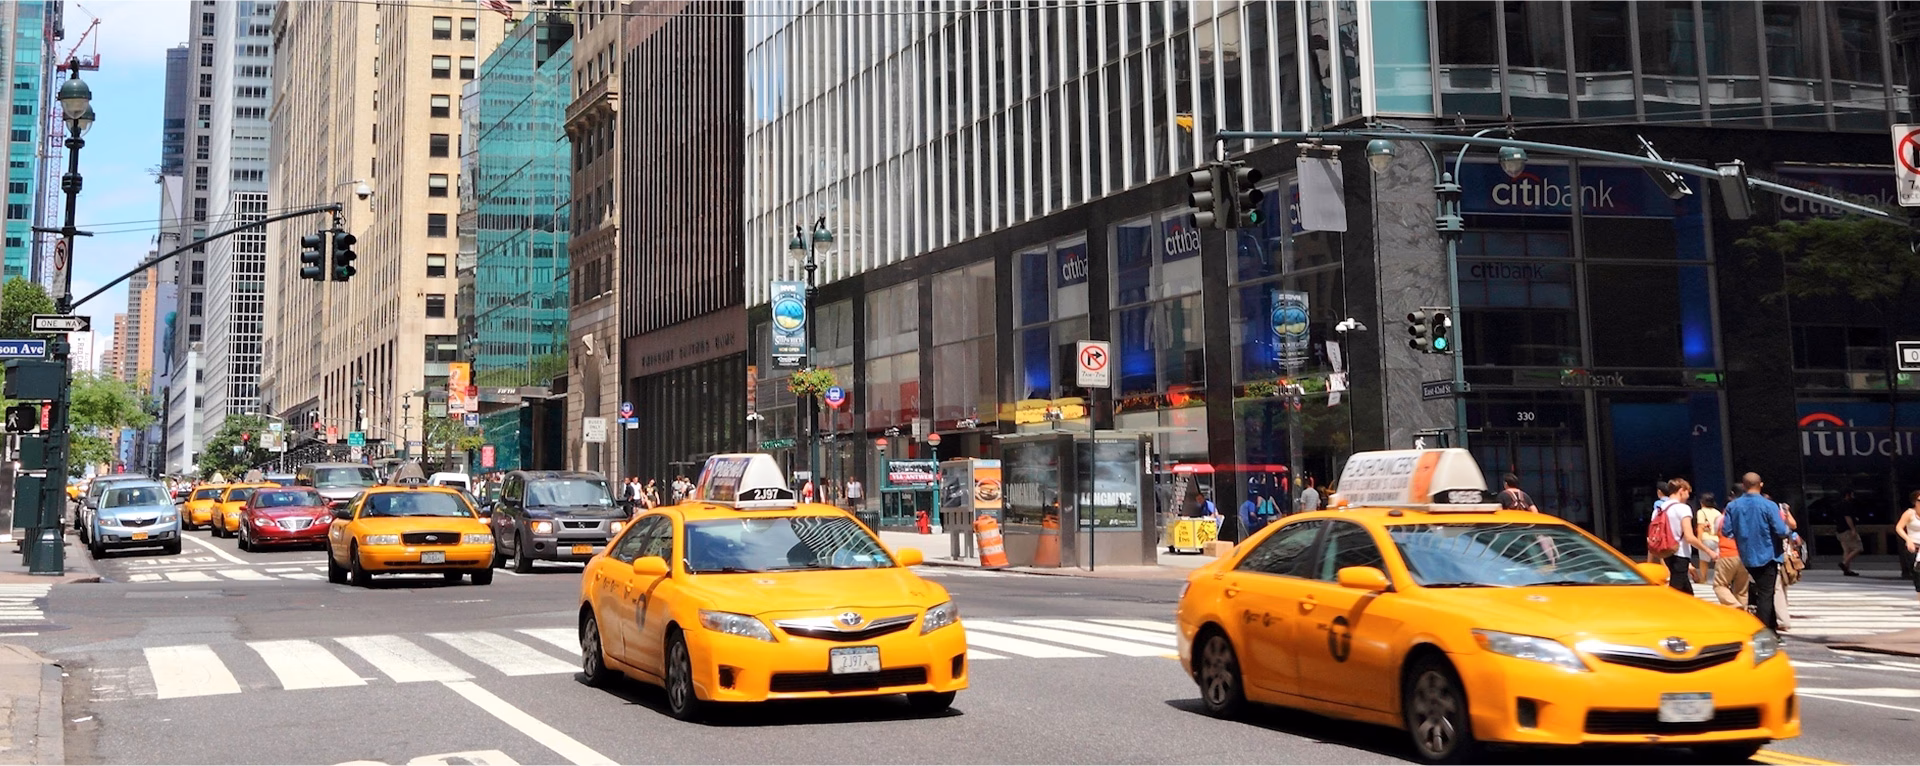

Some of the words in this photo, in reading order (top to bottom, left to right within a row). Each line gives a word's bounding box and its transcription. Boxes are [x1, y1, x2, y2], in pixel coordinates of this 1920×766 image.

[1491, 177, 1615, 208] citibank
[1165, 228, 1200, 256] citiba
[1471, 262, 1545, 279] citibank
[21, 344, 44, 354] Ave
[1517, 411, 1535, 421] 330
[754, 488, 779, 500] 2J97
